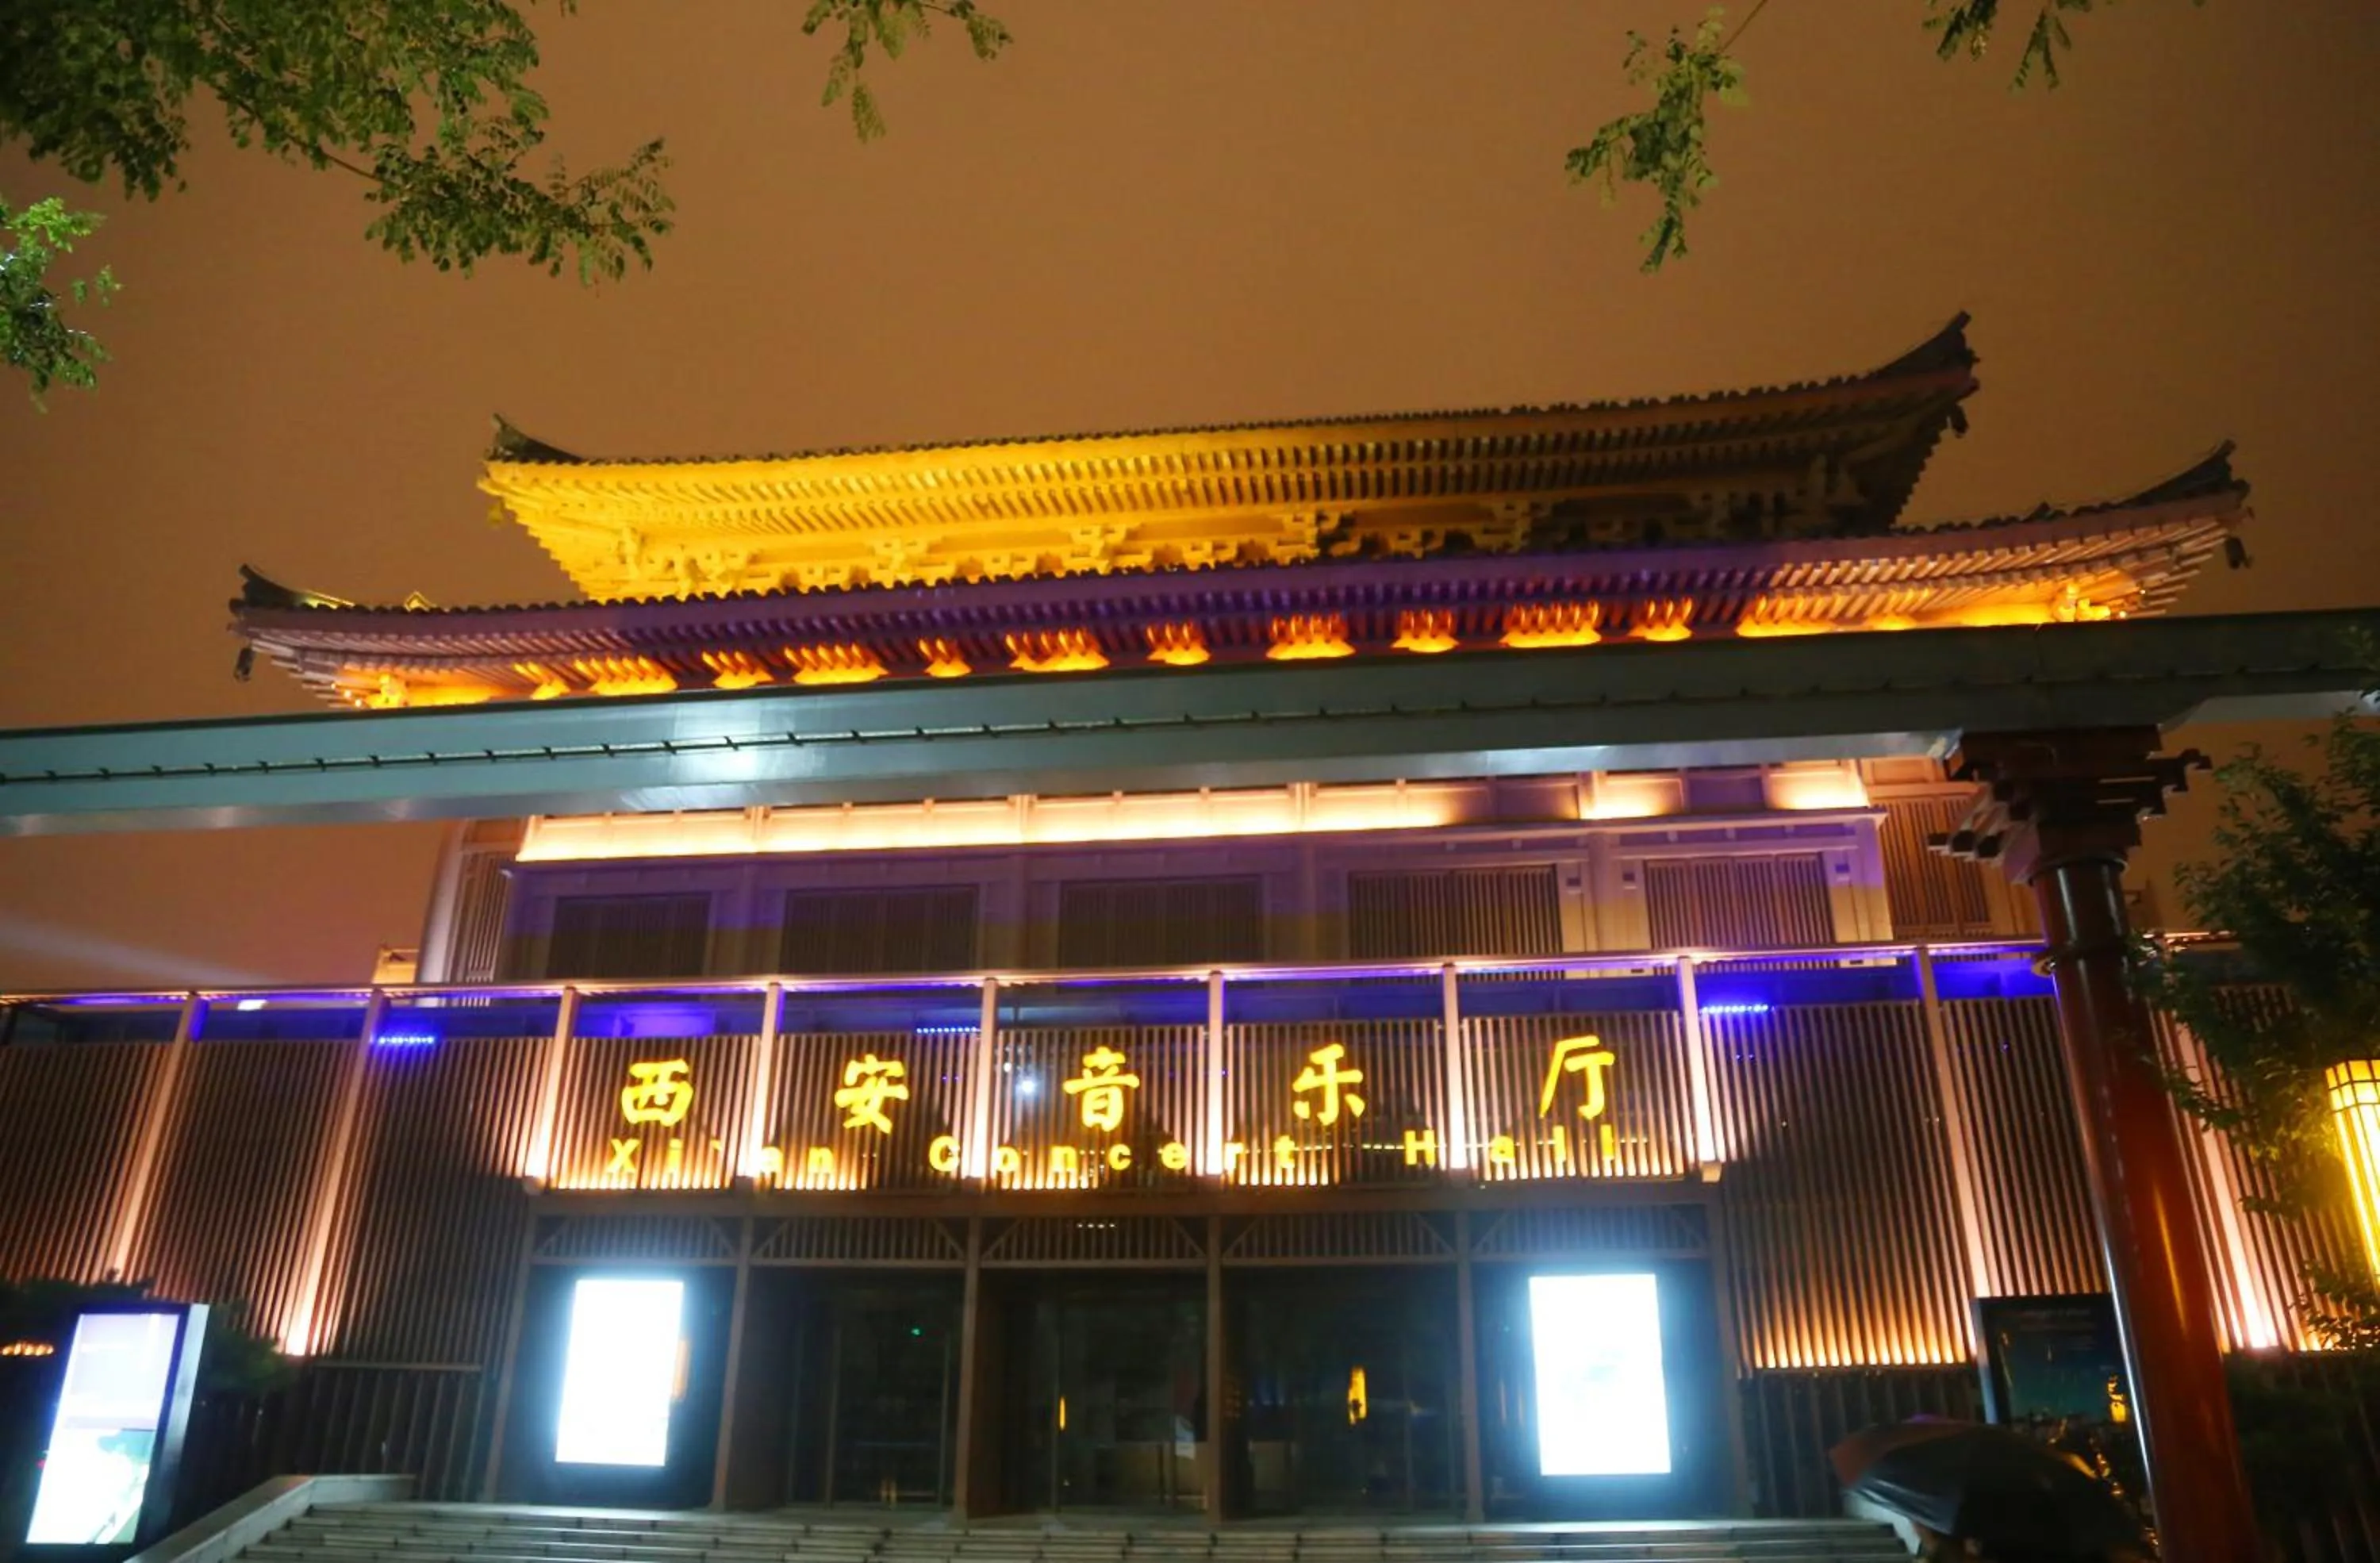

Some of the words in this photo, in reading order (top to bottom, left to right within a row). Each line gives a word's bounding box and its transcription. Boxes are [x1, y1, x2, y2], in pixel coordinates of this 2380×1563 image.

[620, 1035, 1615, 1133] 西安音乐厅
[928, 1135, 1296, 1172] Concert
[1403, 1124, 1614, 1166] Hall
